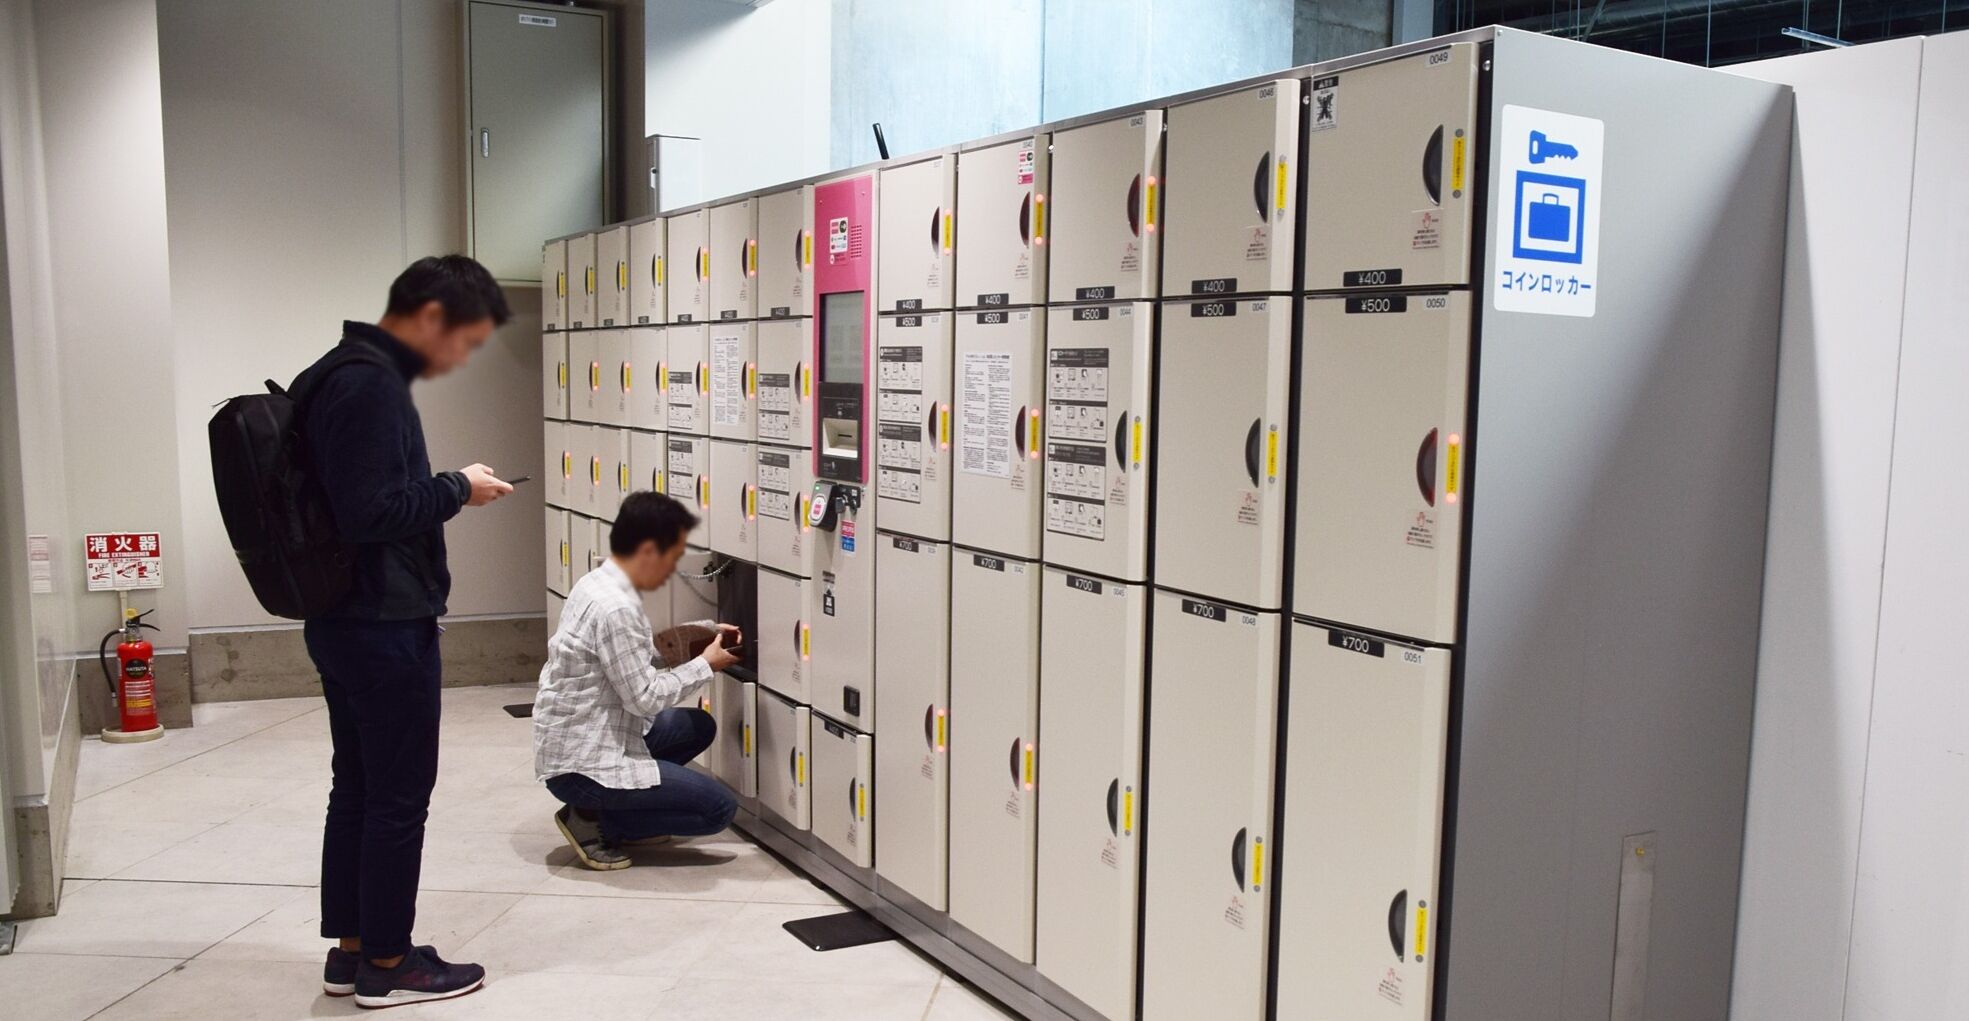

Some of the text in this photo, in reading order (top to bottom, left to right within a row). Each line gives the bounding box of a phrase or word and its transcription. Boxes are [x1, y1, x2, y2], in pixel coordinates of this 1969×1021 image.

[1429, 52, 1448, 64] 0049
[1358, 271, 1386, 284] ¥400
[1502, 270, 1591, 296] コインロッカー
[1203, 280, 1225, 292] ¥400
[985, 294, 1001, 304] ¥400
[1086, 288, 1105, 299] ¥400
[1252, 302, 1267, 312] 0047
[1361, 298, 1390, 312] ¥500
[1426, 298, 1445, 308] 0050
[1082, 309, 1099, 320] ¥500
[1202, 303, 1224, 316] ¥500
[984, 313, 1000, 323] ¥500
[89, 535, 157, 552] 消火器
[981, 558, 997, 569] ¥700
[1075, 578, 1093, 591] ¥700
[1193, 603, 1214, 618] ¥700
[1341, 636, 1369, 653] ¥700
[1404, 651, 1422, 664] 0051
